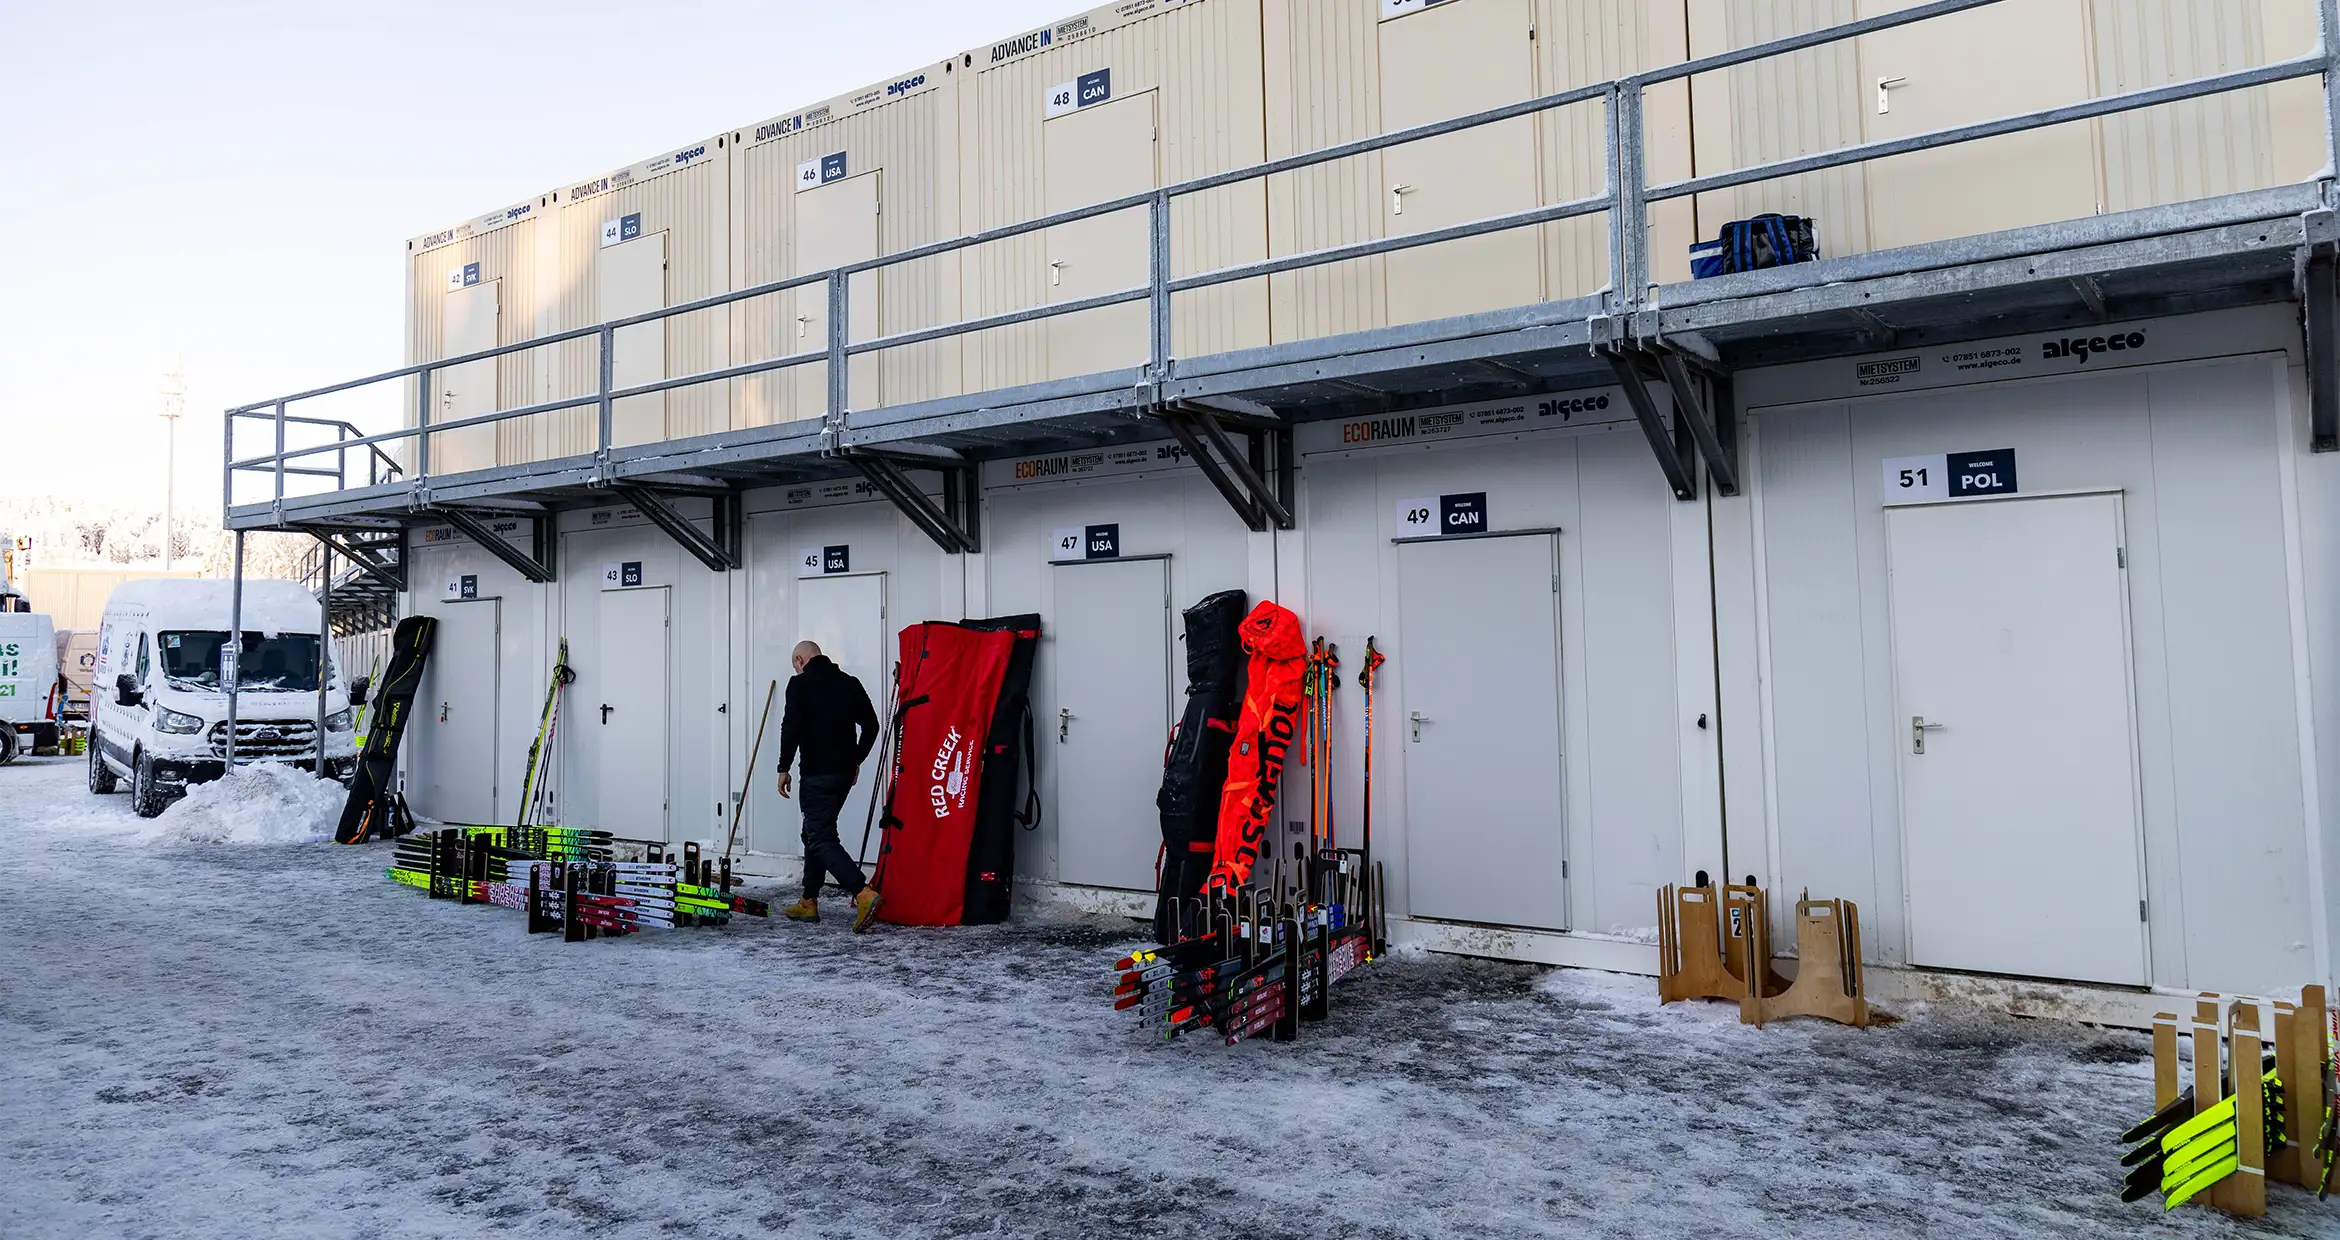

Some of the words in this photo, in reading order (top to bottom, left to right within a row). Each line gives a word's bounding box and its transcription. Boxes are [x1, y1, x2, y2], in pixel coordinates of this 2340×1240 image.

[991, 33, 1038, 63] ADVANCE
[1040, 28, 1052, 47] IN
[887, 75, 925, 97] algeco
[1083, 85, 1105, 100] CAN
[1053, 91, 1070, 107] 48
[755, 118, 792, 143] ADVANCE
[793, 114, 802, 131] IN
[802, 168, 816, 182] 46
[825, 166, 842, 179] USA
[570, 179, 600, 202] ADVANCE
[600, 177, 608, 192] IN
[606, 226, 617, 239] 44
[624, 225, 637, 236] SLO
[422, 231, 447, 249] ADVANCE
[447, 229, 454, 241] IN
[452, 274, 460, 284] 42
[466, 272, 477, 283] SVK
[1952, 352, 1978, 362] 07851
[1980, 347, 2021, 358] 6873-002
[2042, 331, 2146, 365] algeco
[1859, 358, 1918, 376] MIETSYSTEM
[1957, 357, 2022, 371] www.algeco.de
[1539, 396, 1609, 421] algeco
[1420, 412, 1462, 427] MIETSYSTEM
[1343, 416, 1416, 443] ECORAUM
[1015, 456, 1069, 479] ECORAUM
[1899, 468, 1929, 488] 51
[1961, 472, 2003, 490] POL
[1406, 507, 1430, 524] 49
[1448, 511, 1479, 526] CAN
[1061, 536, 1078, 550] 47
[1091, 540, 1113, 552] USA
[805, 555, 818, 567] 45
[828, 559, 845, 569] USA
[606, 570, 618, 581] 43
[625, 574, 638, 583] SLO
[448, 582, 457, 592] 41
[463, 586, 475, 594] SVK
[931, 727, 962, 781] CREEK
[930, 784, 950, 819] RED
[490, 882, 525, 895] MADSHUS
[489, 896, 526, 911] MADSHUS
